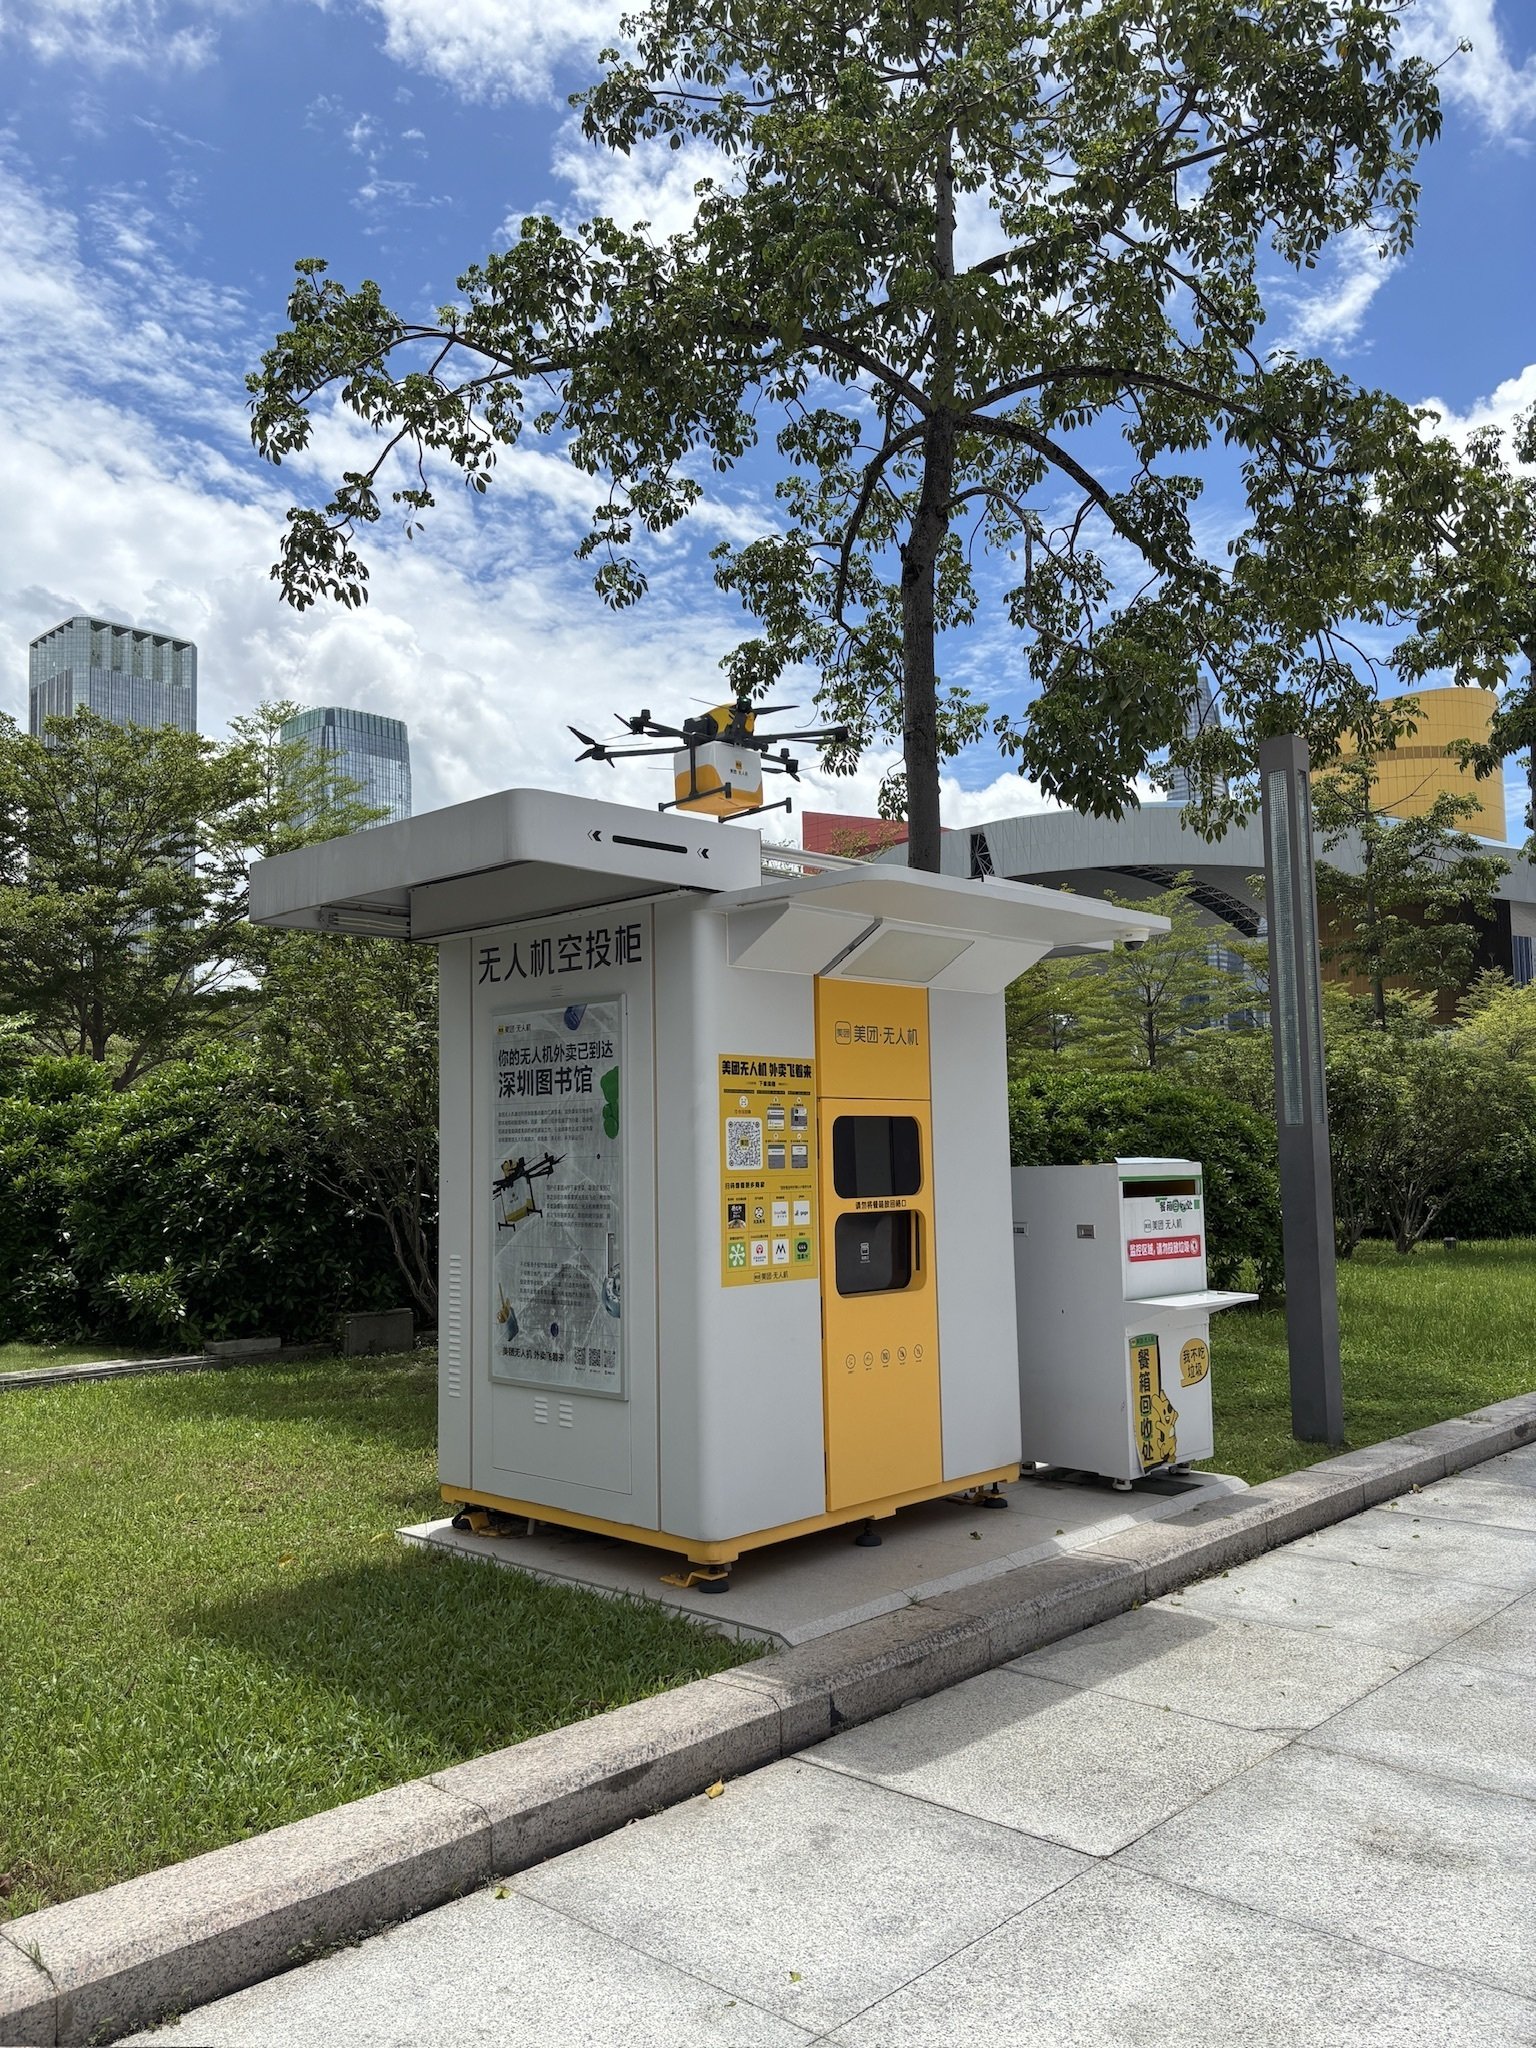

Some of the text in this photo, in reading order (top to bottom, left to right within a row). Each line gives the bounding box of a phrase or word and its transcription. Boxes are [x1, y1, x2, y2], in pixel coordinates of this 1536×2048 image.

[478, 923, 643, 985] 无人机空投柜
[498, 1040, 614, 1067] 你的无人机外卖已到达
[498, 1065, 593, 1099] 深圳图书馆
[722, 1060, 812, 1079] 美团无人机 外卖飞着来
[1183, 1347, 1206, 1364] 我不吃
[1138, 1348, 1154, 1461] 餐箱回收处
